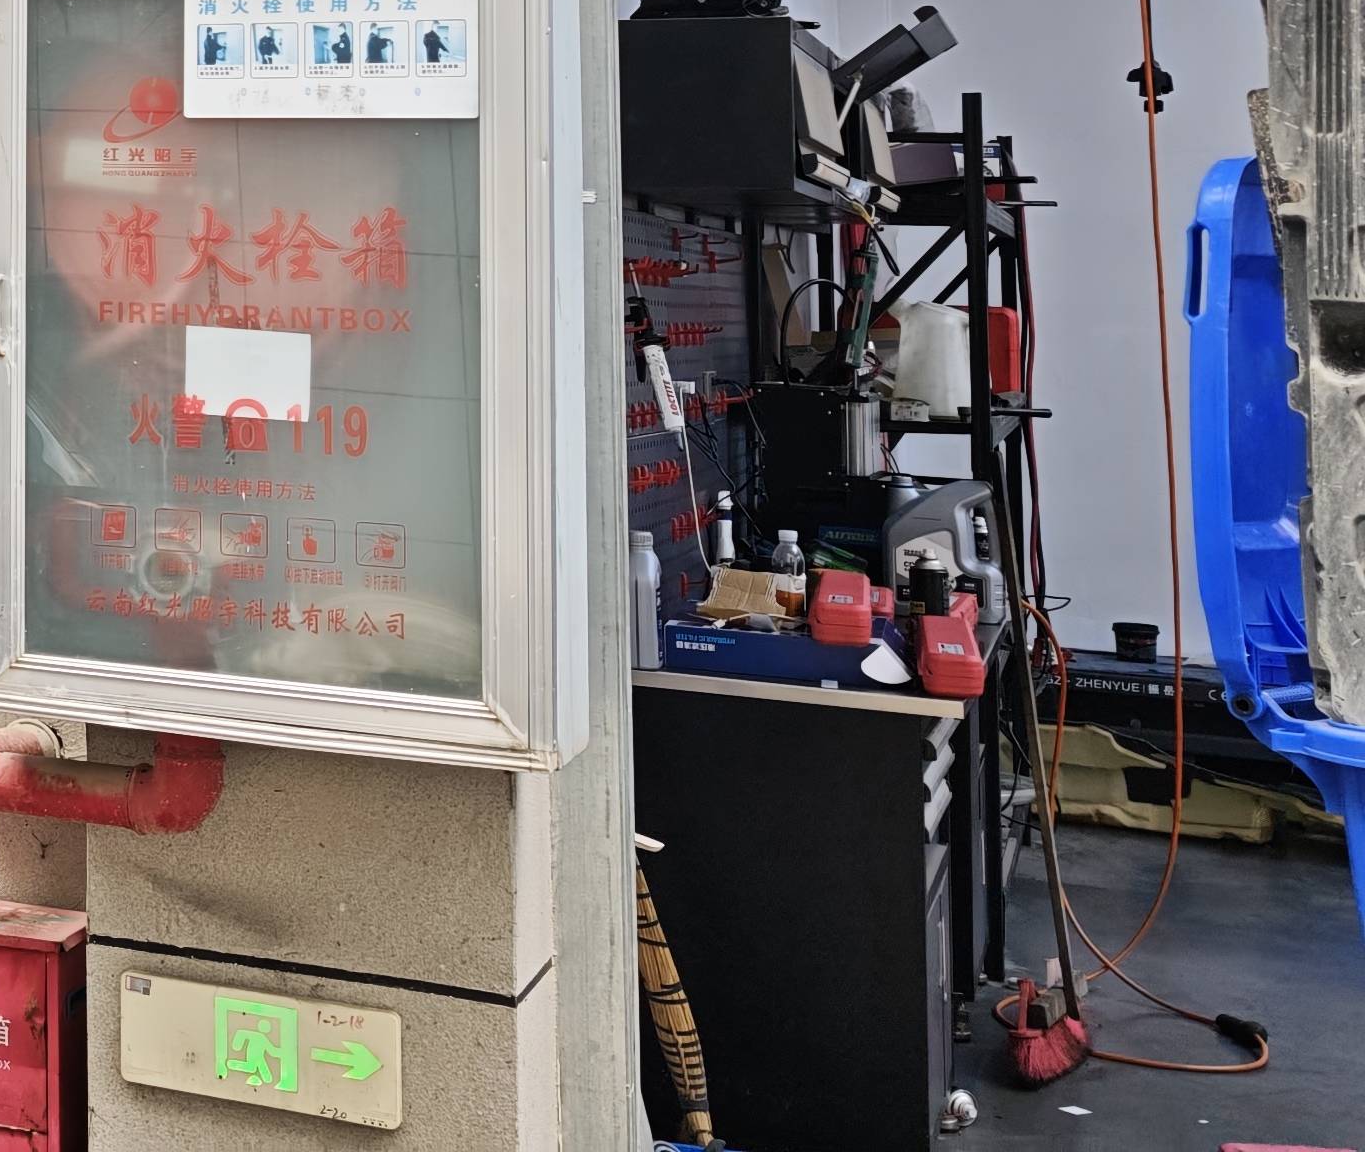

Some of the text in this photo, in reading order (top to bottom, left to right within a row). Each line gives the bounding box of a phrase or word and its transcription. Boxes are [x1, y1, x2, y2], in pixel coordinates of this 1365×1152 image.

[98, 203, 411, 290] 消火栓箱
[128, 393, 206, 449] 火警
[286, 403, 368, 459] 119
[172, 475, 317, 501] 消火栓使用方法
[1075, 677, 1140, 693] ZHENYUE
